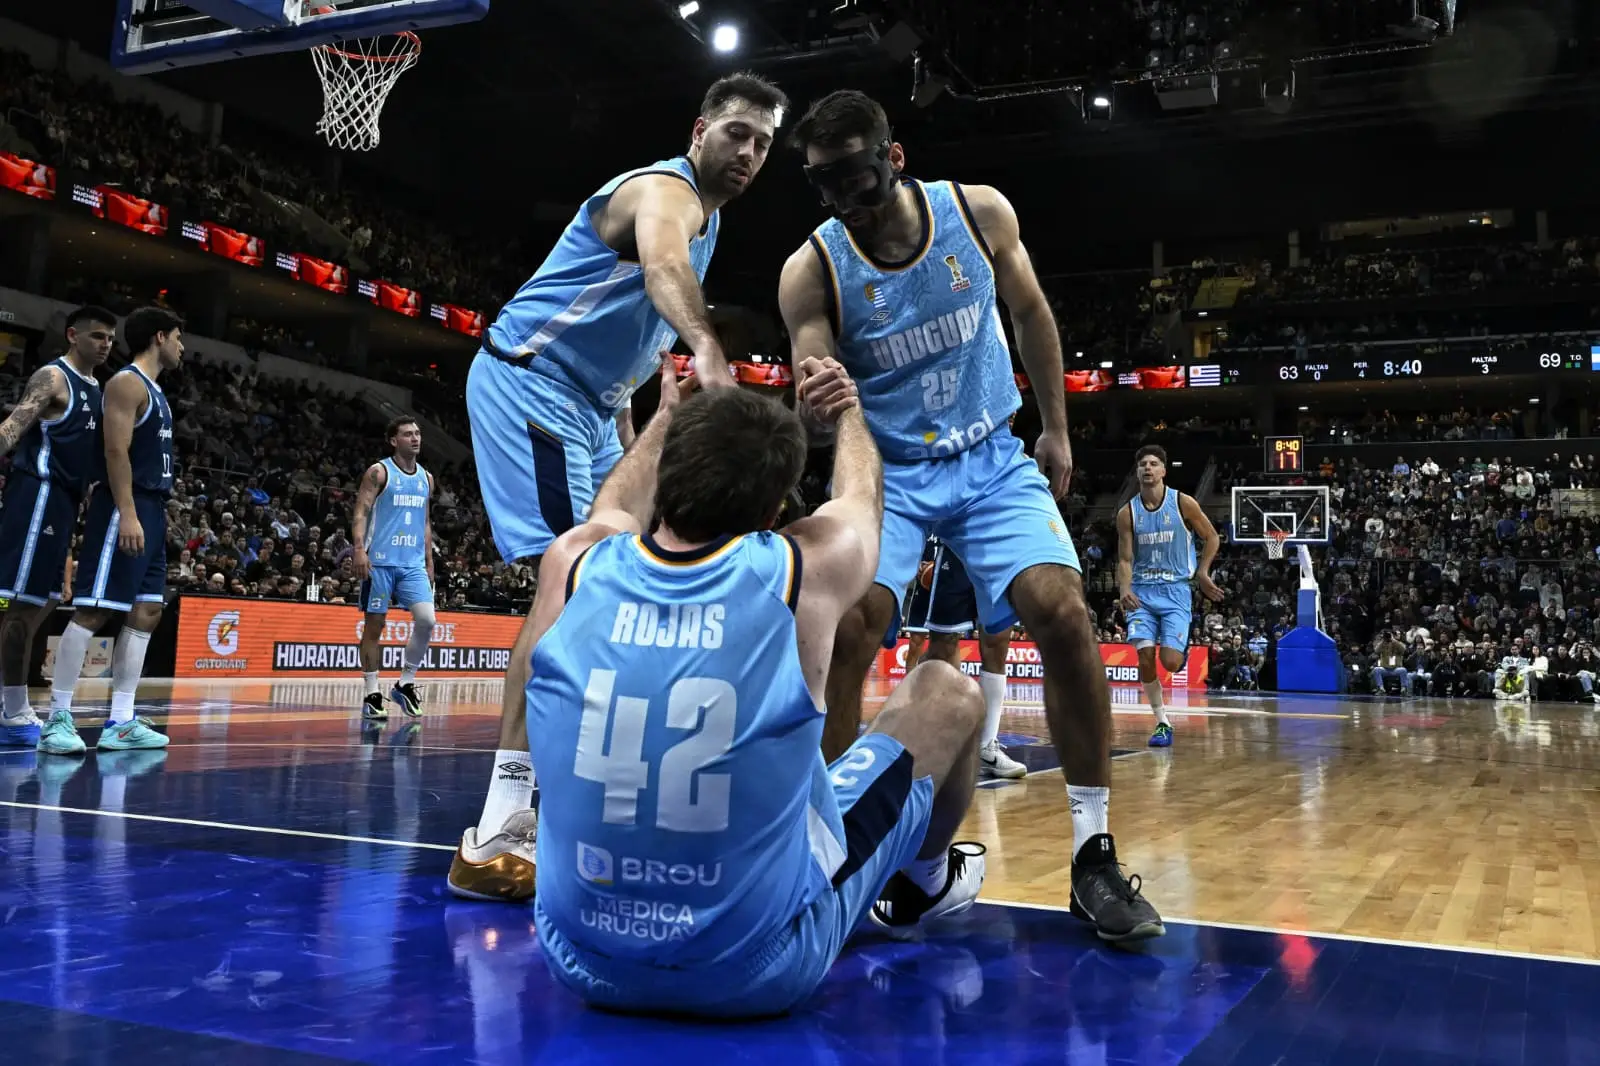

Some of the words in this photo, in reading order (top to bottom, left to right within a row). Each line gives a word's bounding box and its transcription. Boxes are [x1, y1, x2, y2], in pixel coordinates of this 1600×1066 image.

[870, 301, 980, 370] URUGUAY
[1383, 359, 1422, 376] 8:40
[1471, 356, 1498, 364] FALTAS
[1540, 353, 1561, 368] 69
[1279, 366, 1299, 380] 63
[1314, 371, 1321, 381] 0
[1358, 370, 1365, 378] 4
[1481, 363, 1489, 374] 3
[920, 368, 958, 413] 25
[1275, 440, 1300, 451] 8:40
[1280, 451, 1296, 469] 17
[610, 601, 725, 649] ROJAS
[195, 658, 247, 669] GATORADE
[276, 644, 362, 668] HIDRATAD
[440, 648, 456, 668] DE
[459, 648, 475, 669] LA
[479, 649, 510, 669] FUBB
[1105, 666, 1138, 681] FUBB
[574, 668, 737, 833] 42
[498, 773, 528, 781] umbro
[621, 857, 723, 886] BROU
[597, 898, 694, 925] MEDICA
